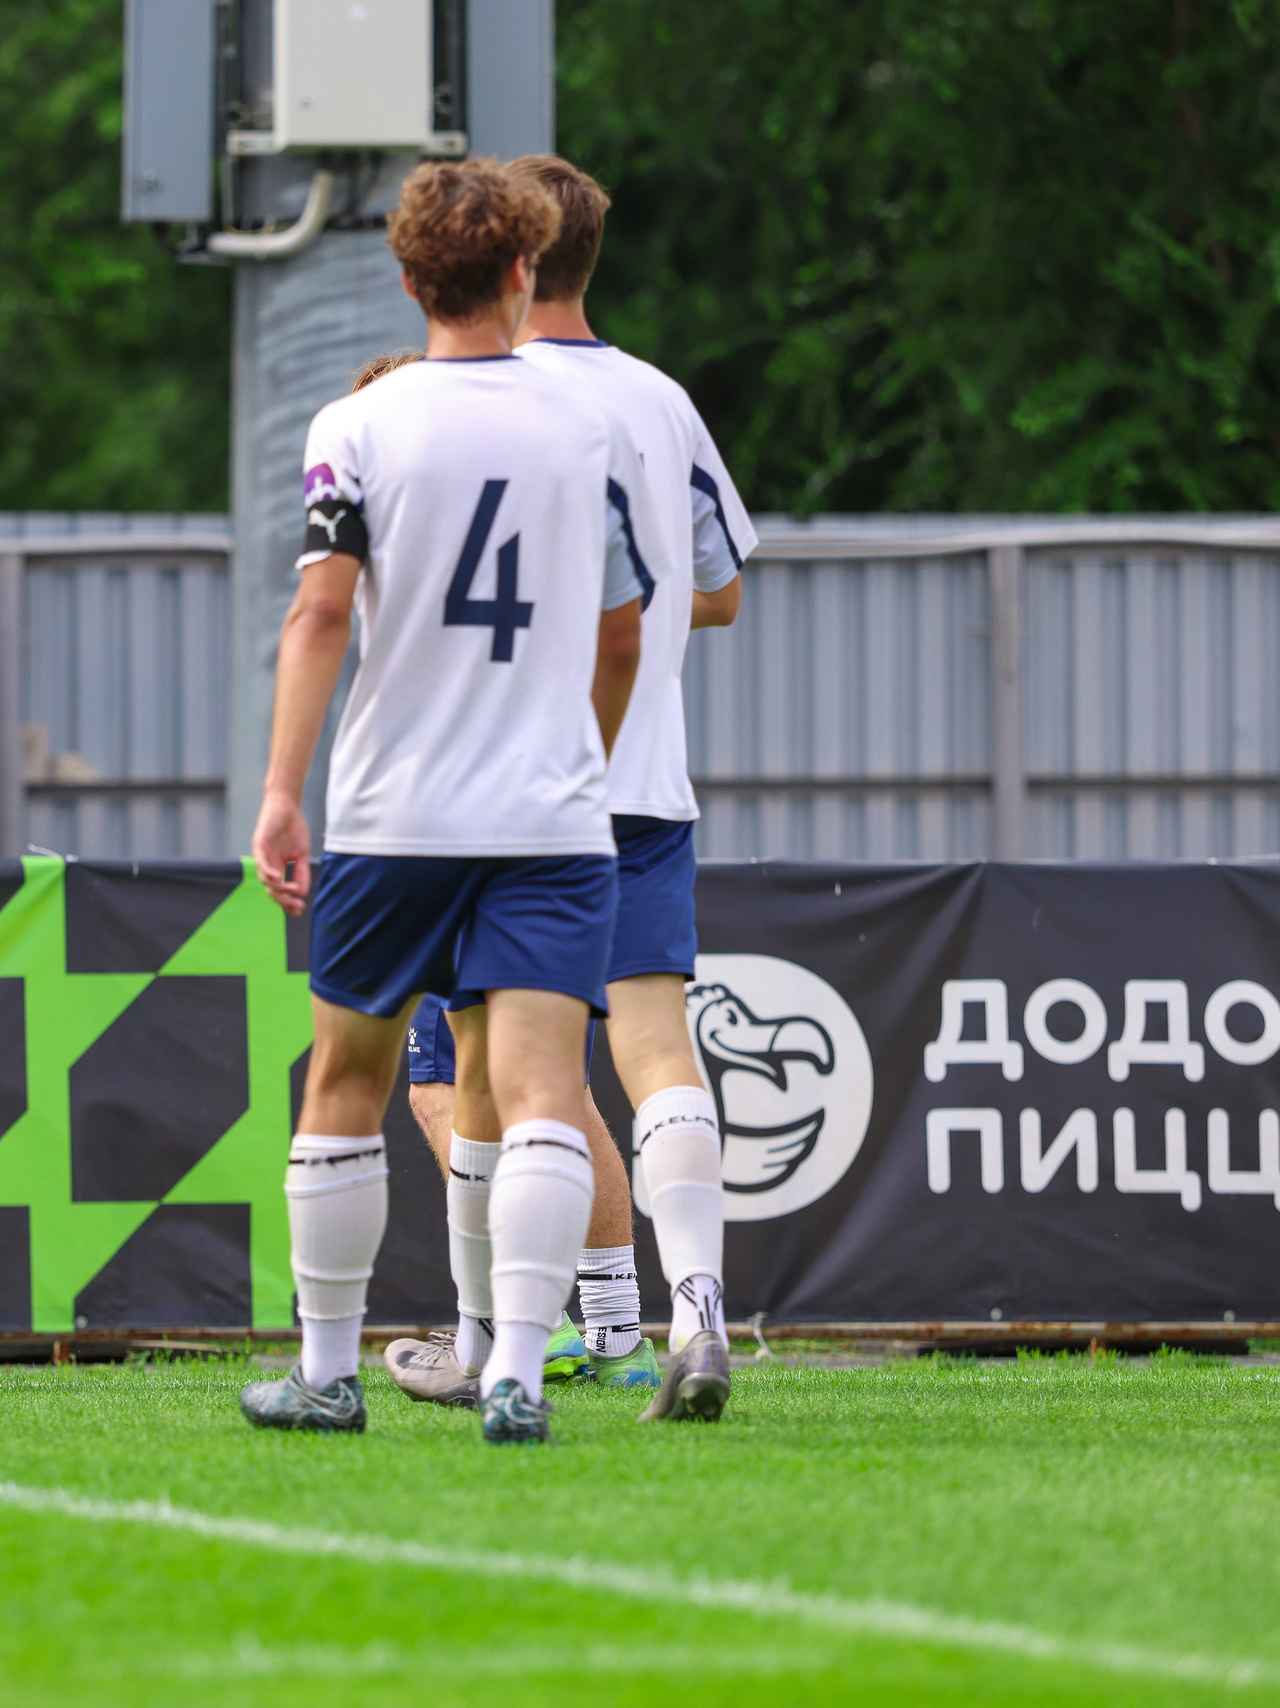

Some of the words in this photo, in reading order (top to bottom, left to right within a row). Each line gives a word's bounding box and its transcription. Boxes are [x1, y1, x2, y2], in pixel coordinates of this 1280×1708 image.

[442, 479, 534, 662] 4
[924, 978, 1280, 1082] ДОДО
[926, 1107, 1280, 1212] ПИЦЦ
